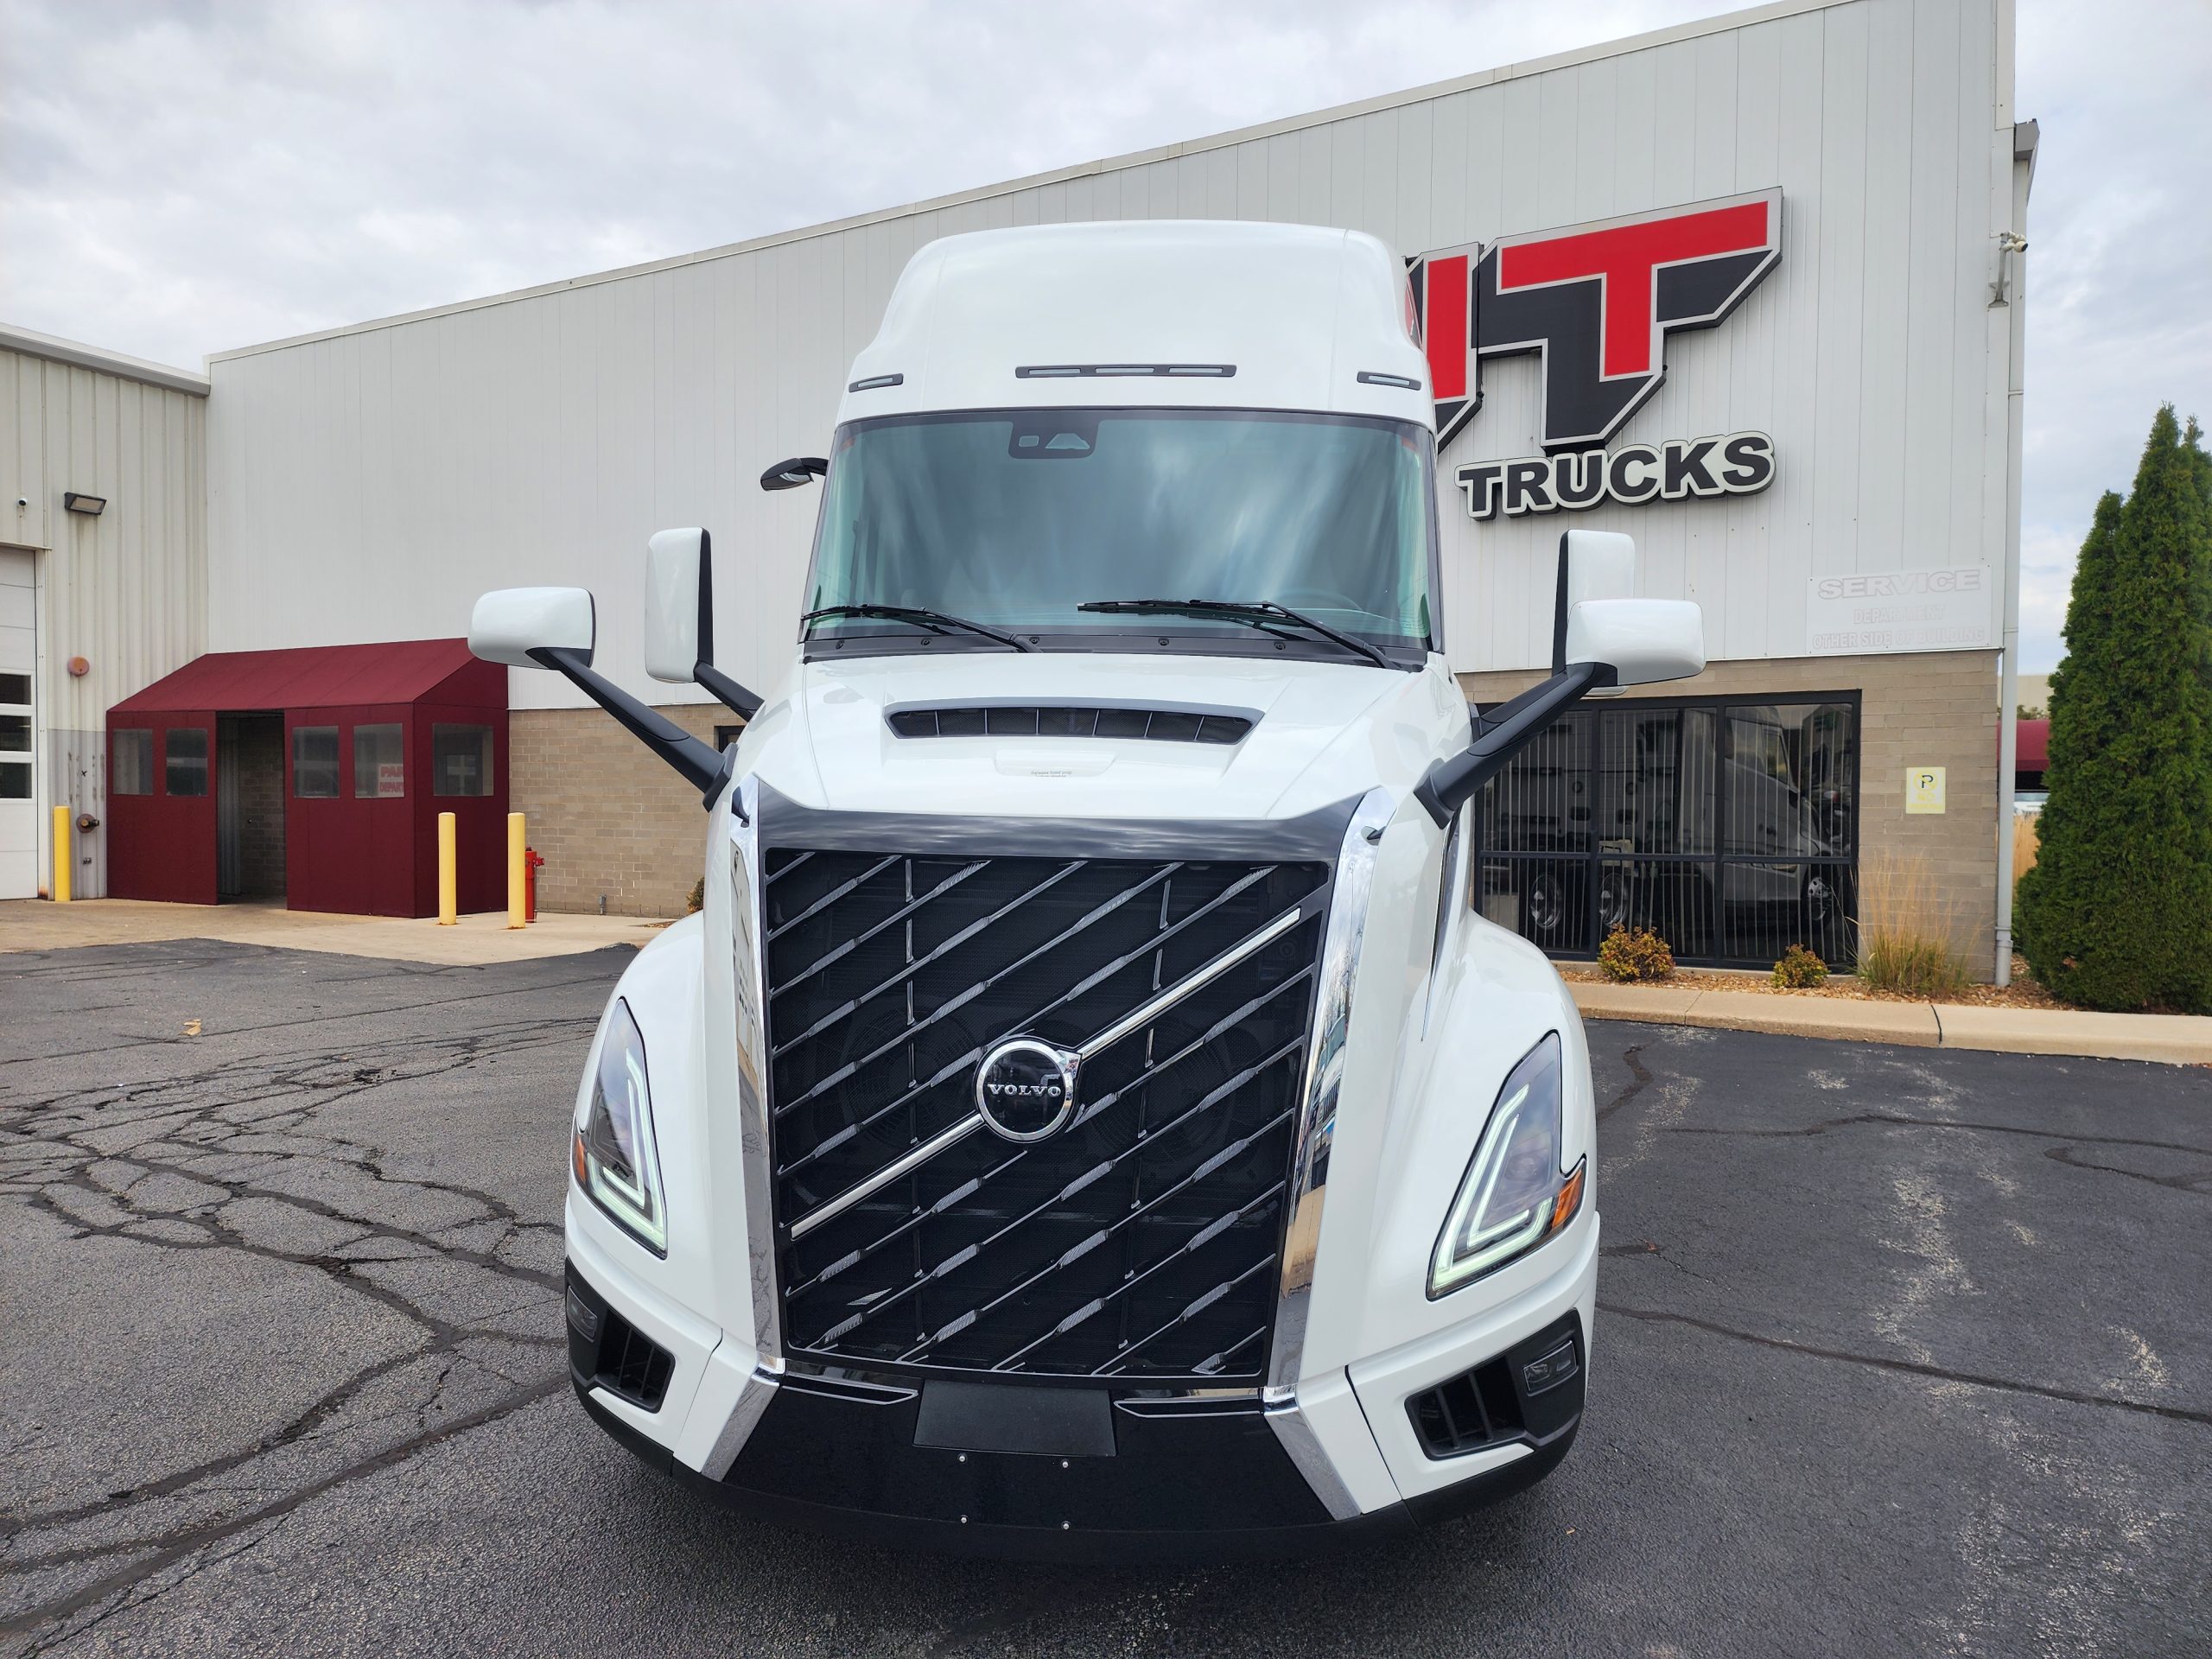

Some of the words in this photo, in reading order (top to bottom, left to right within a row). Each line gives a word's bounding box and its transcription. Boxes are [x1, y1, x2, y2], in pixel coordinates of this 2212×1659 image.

[1456, 431, 1774, 516] TRUCKS
[1818, 569, 1980, 600] SERVICE
[1853, 605, 1945, 624] DEPARTMENT
[1813, 632, 1858, 649] OTHER
[1859, 630, 1892, 646] SIDE
[1896, 629, 1913, 645] OF
[1916, 626, 1985, 644] BUILDING
[1921, 774, 1934, 789] P
[987, 1084, 1062, 1097] VOLVO
